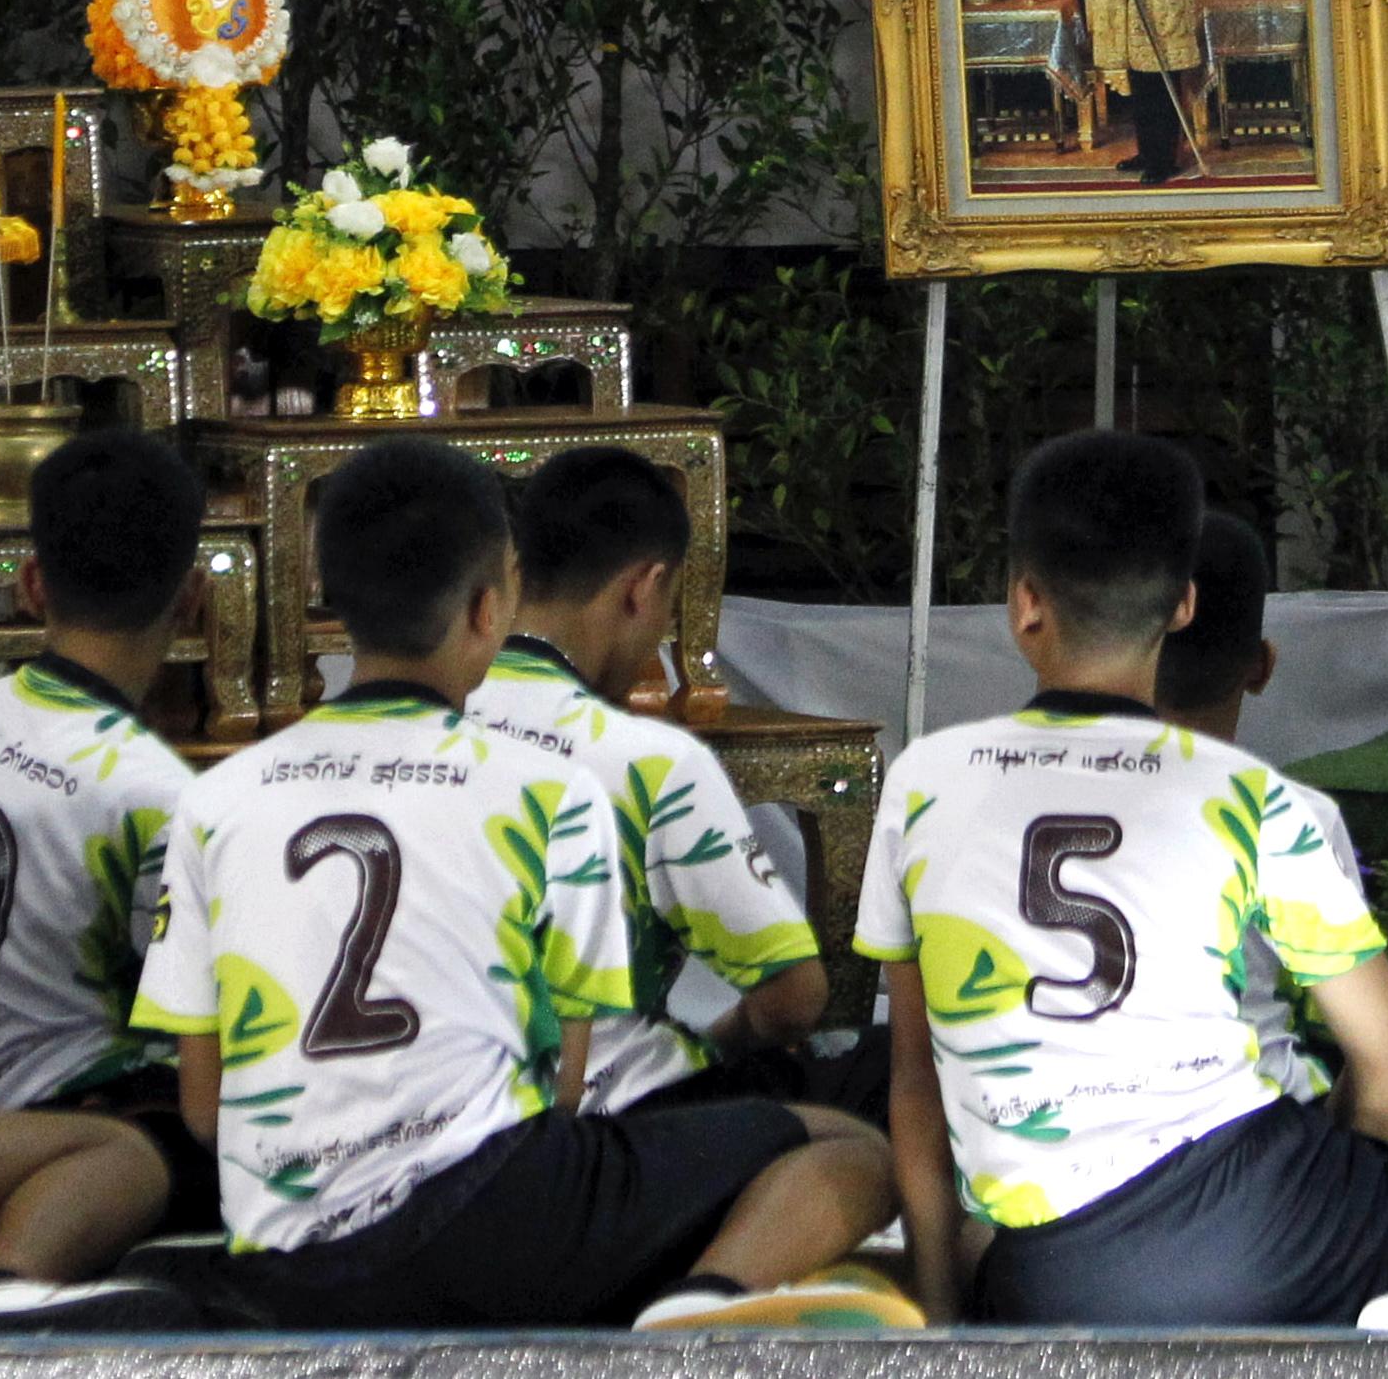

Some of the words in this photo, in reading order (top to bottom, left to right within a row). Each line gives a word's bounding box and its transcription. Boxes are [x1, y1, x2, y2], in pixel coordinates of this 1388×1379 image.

[370, 757, 467, 793] สุธรรม
[284, 813, 419, 1062] 2
[1019, 815, 1135, 1021] 5
